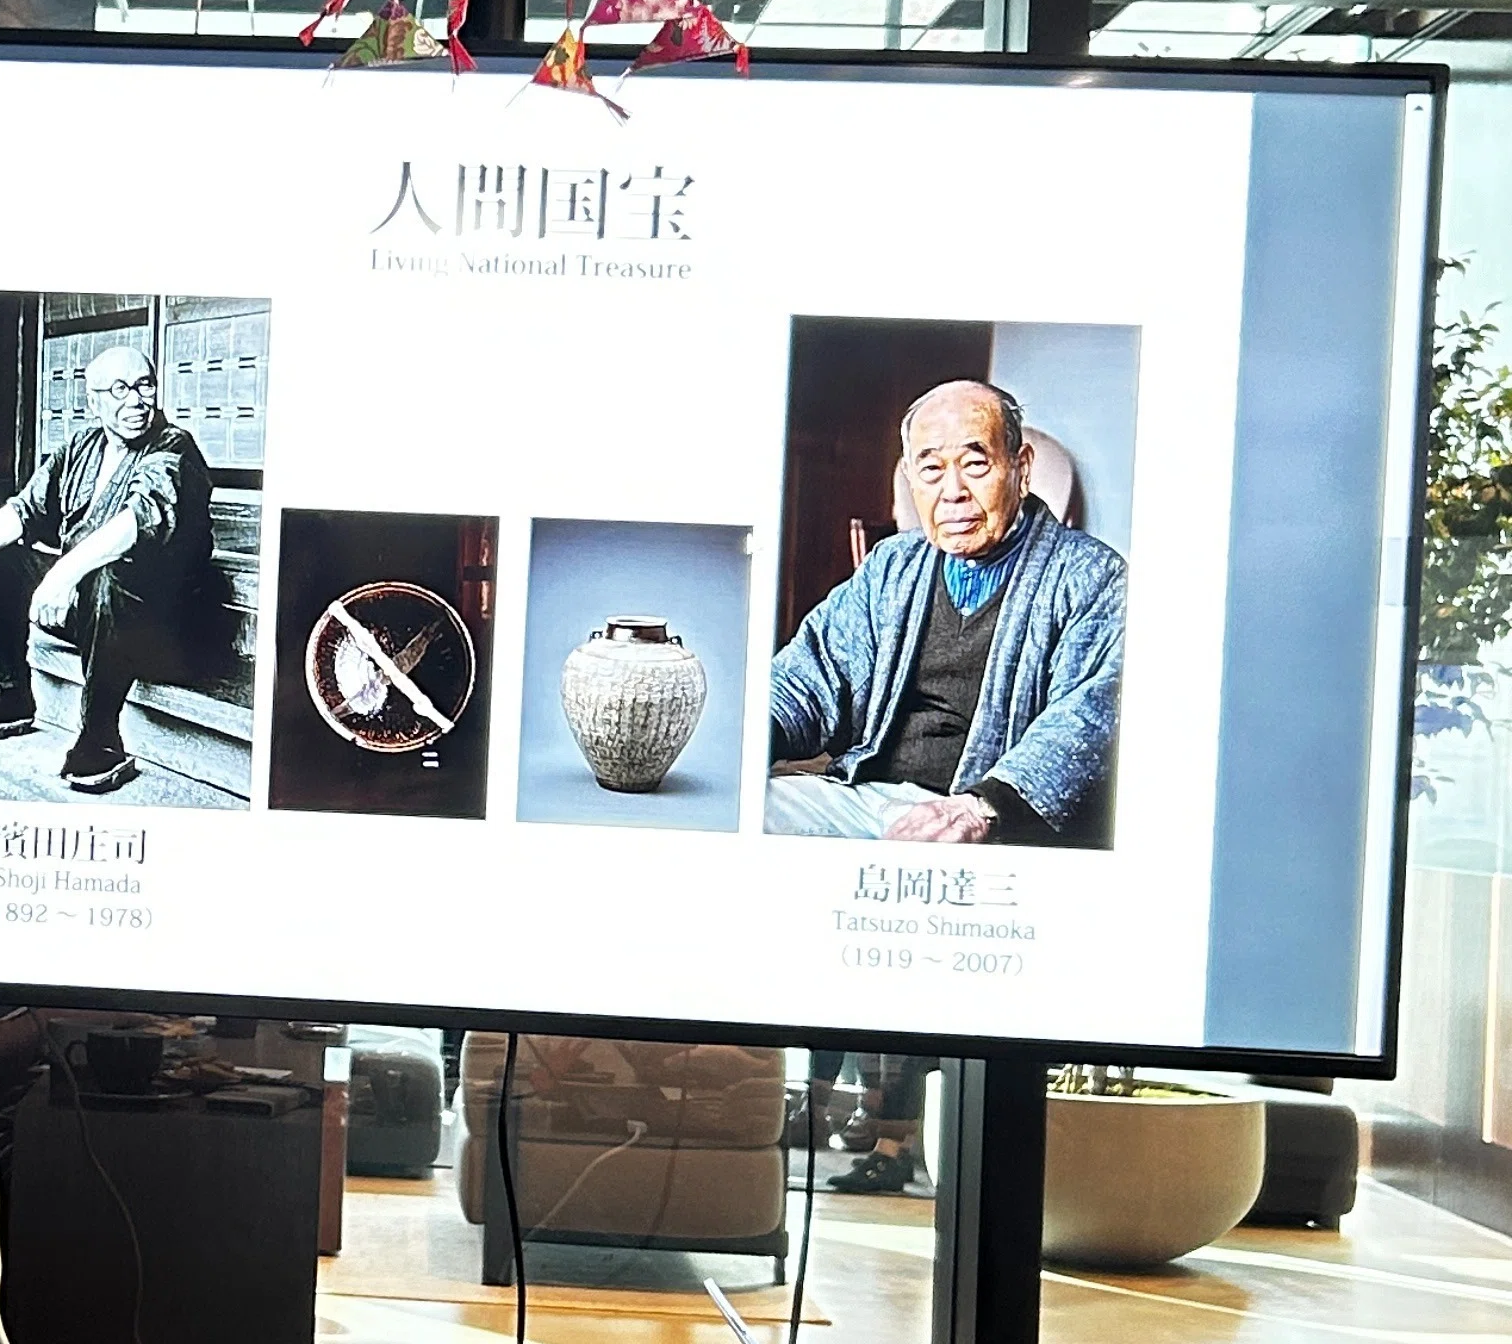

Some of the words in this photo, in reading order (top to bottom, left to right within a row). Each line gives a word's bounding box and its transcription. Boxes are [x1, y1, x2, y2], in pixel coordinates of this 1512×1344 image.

[369, 160, 696, 240] 人間国宝
[370, 248, 449, 277] Living
[460, 251, 566, 276] National
[576, 253, 693, 279] Treasure
[54, 870, 141, 894] Hamada
[832, 909, 919, 935] Tatsuzo
[926, 915, 1036, 941] Shimaoka
